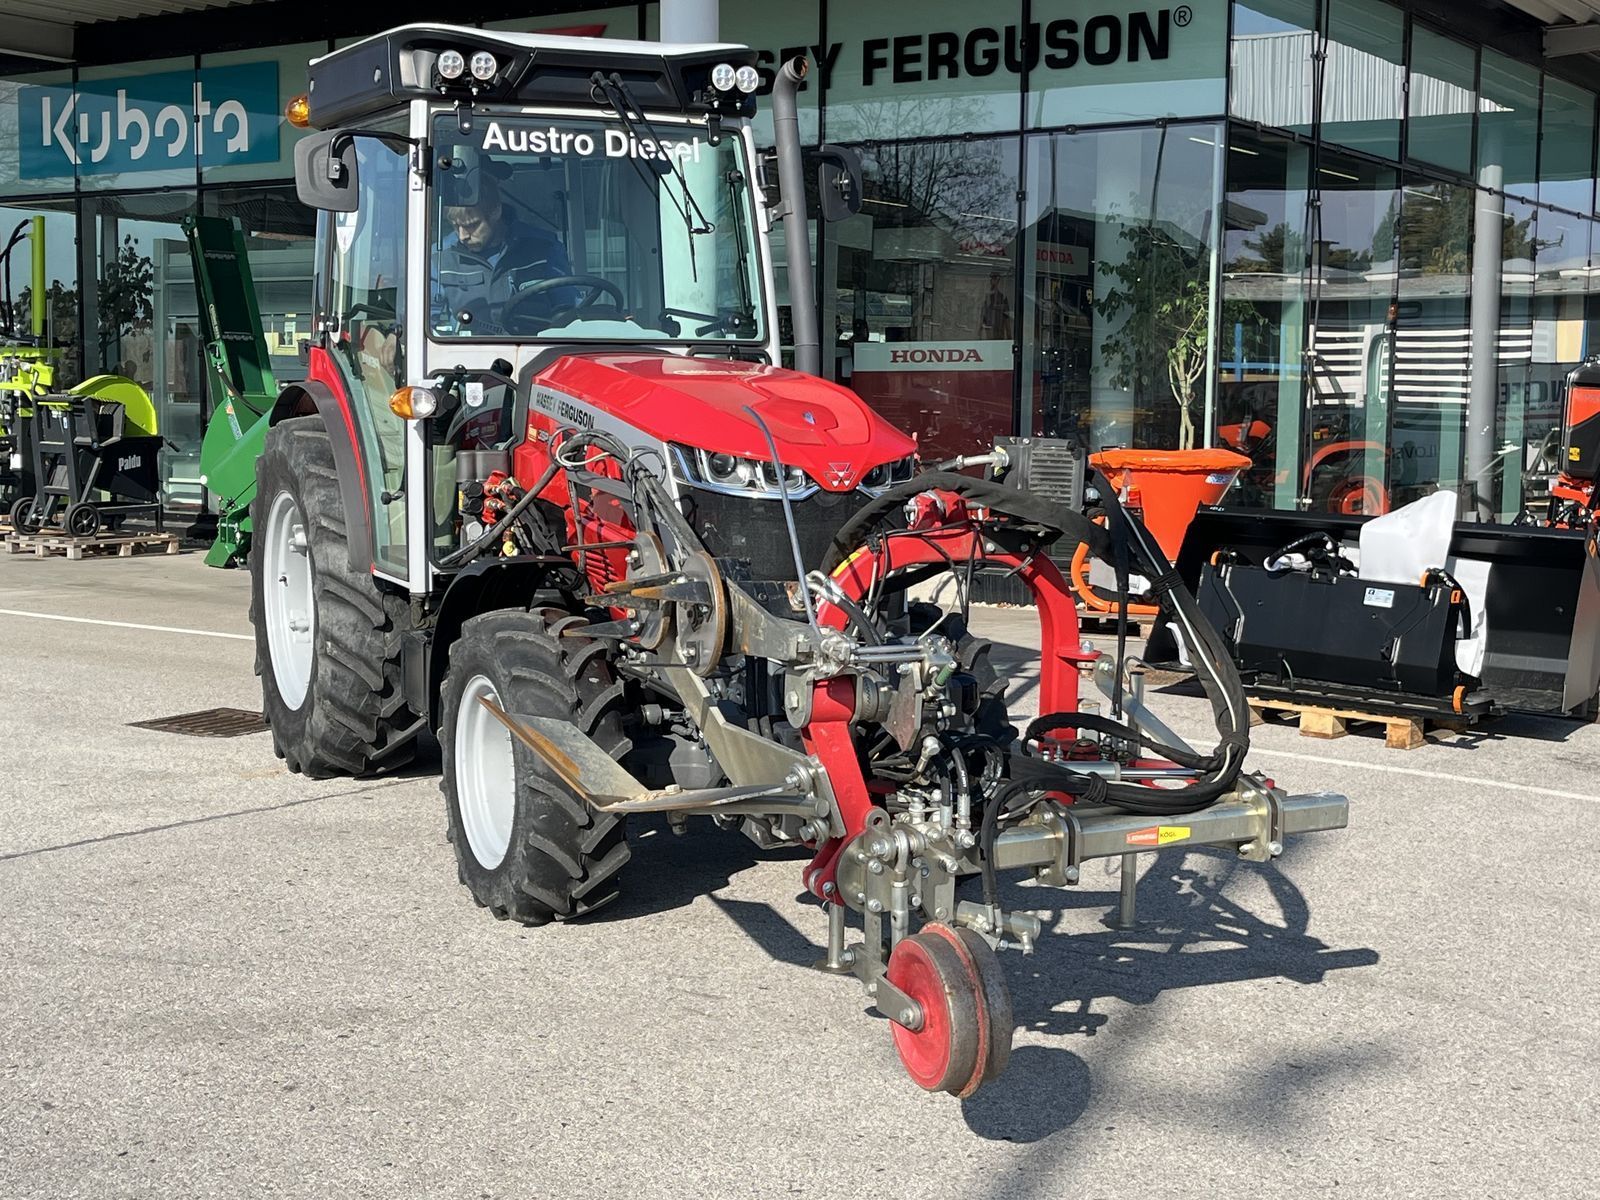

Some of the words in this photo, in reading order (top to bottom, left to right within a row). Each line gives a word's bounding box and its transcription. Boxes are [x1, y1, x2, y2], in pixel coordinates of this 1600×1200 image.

[42, 82, 249, 165] Kubota
[482, 122, 594, 156] Austro
[605, 129, 699, 163] Diesel
[890, 349, 984, 363] HONDA
[557, 400, 595, 429] FERGUSON
